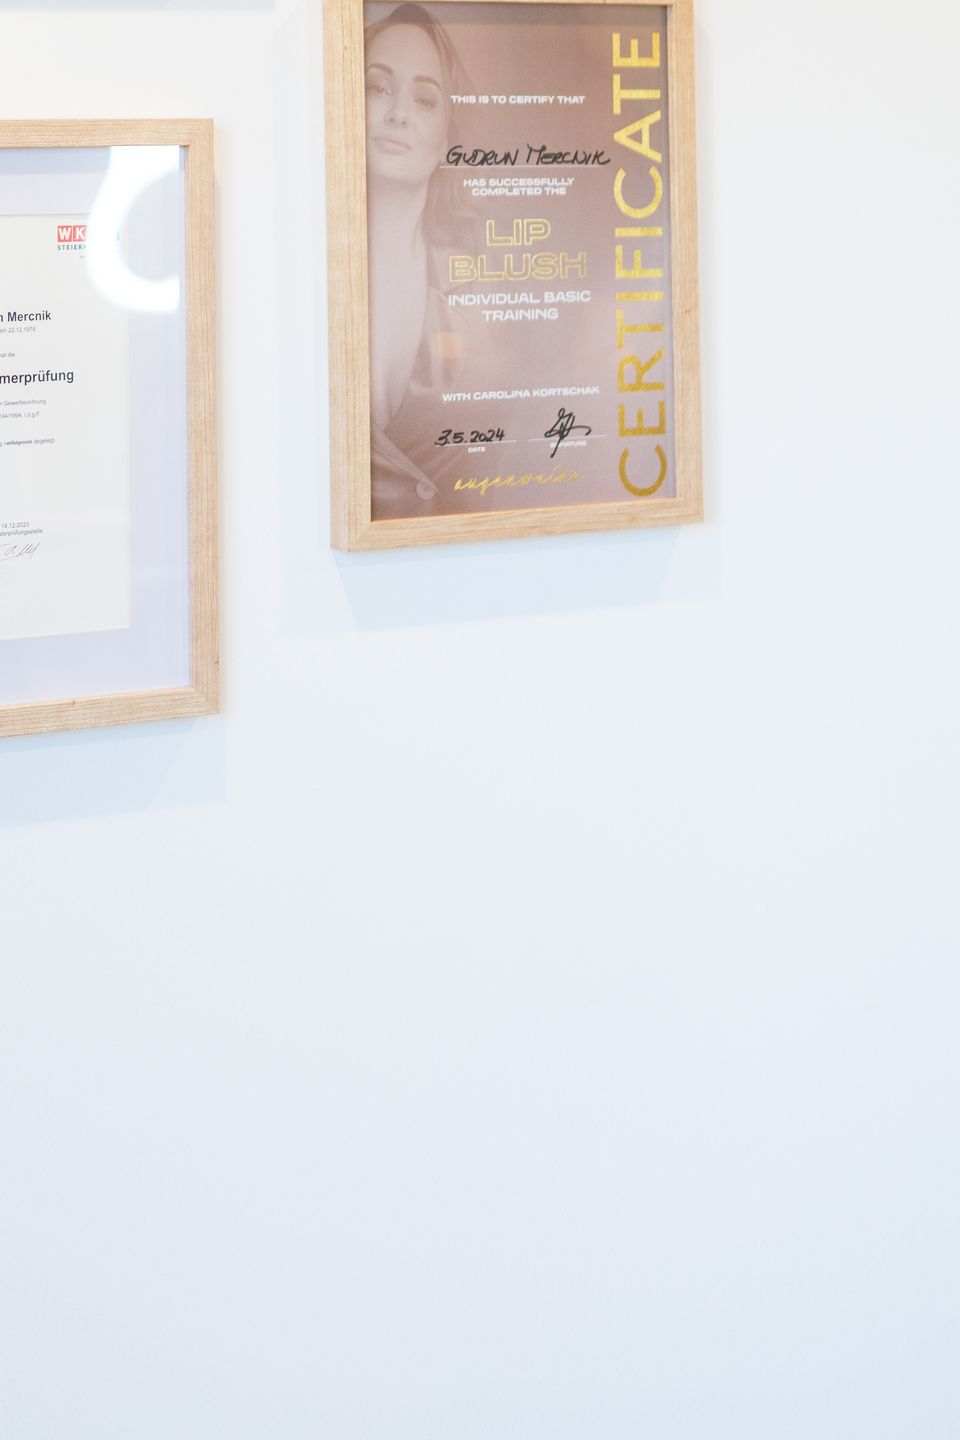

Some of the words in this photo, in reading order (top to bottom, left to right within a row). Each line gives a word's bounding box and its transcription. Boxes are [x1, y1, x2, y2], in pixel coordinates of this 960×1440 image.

[451, 95, 476, 104] THIS
[479, 95, 489, 104] IS
[491, 95, 505, 104] TO
[509, 95, 555, 104] CERTIFY
[557, 95, 585, 104] THAT
[464, 178, 486, 187] HAS
[489, 177, 574, 187] SUCCESSFULLY
[472, 188, 542, 196] COMPLETED
[545, 187, 566, 195] THE
[486, 218, 551, 246] LIP
[448, 251, 587, 282] BLUSH
[612, 32, 667, 497] CERTIFICATE
[448, 291, 540, 306] INDIVIDUAL
[544, 290, 591, 303] BASIC
[7, 310, 52, 322] Mercnik
[482, 308, 559, 322] TRAINING
[442, 392, 471, 402] WITH
[474, 389, 530, 401] CAROLINA
[533, 386, 600, 397] KORTSCHAK
